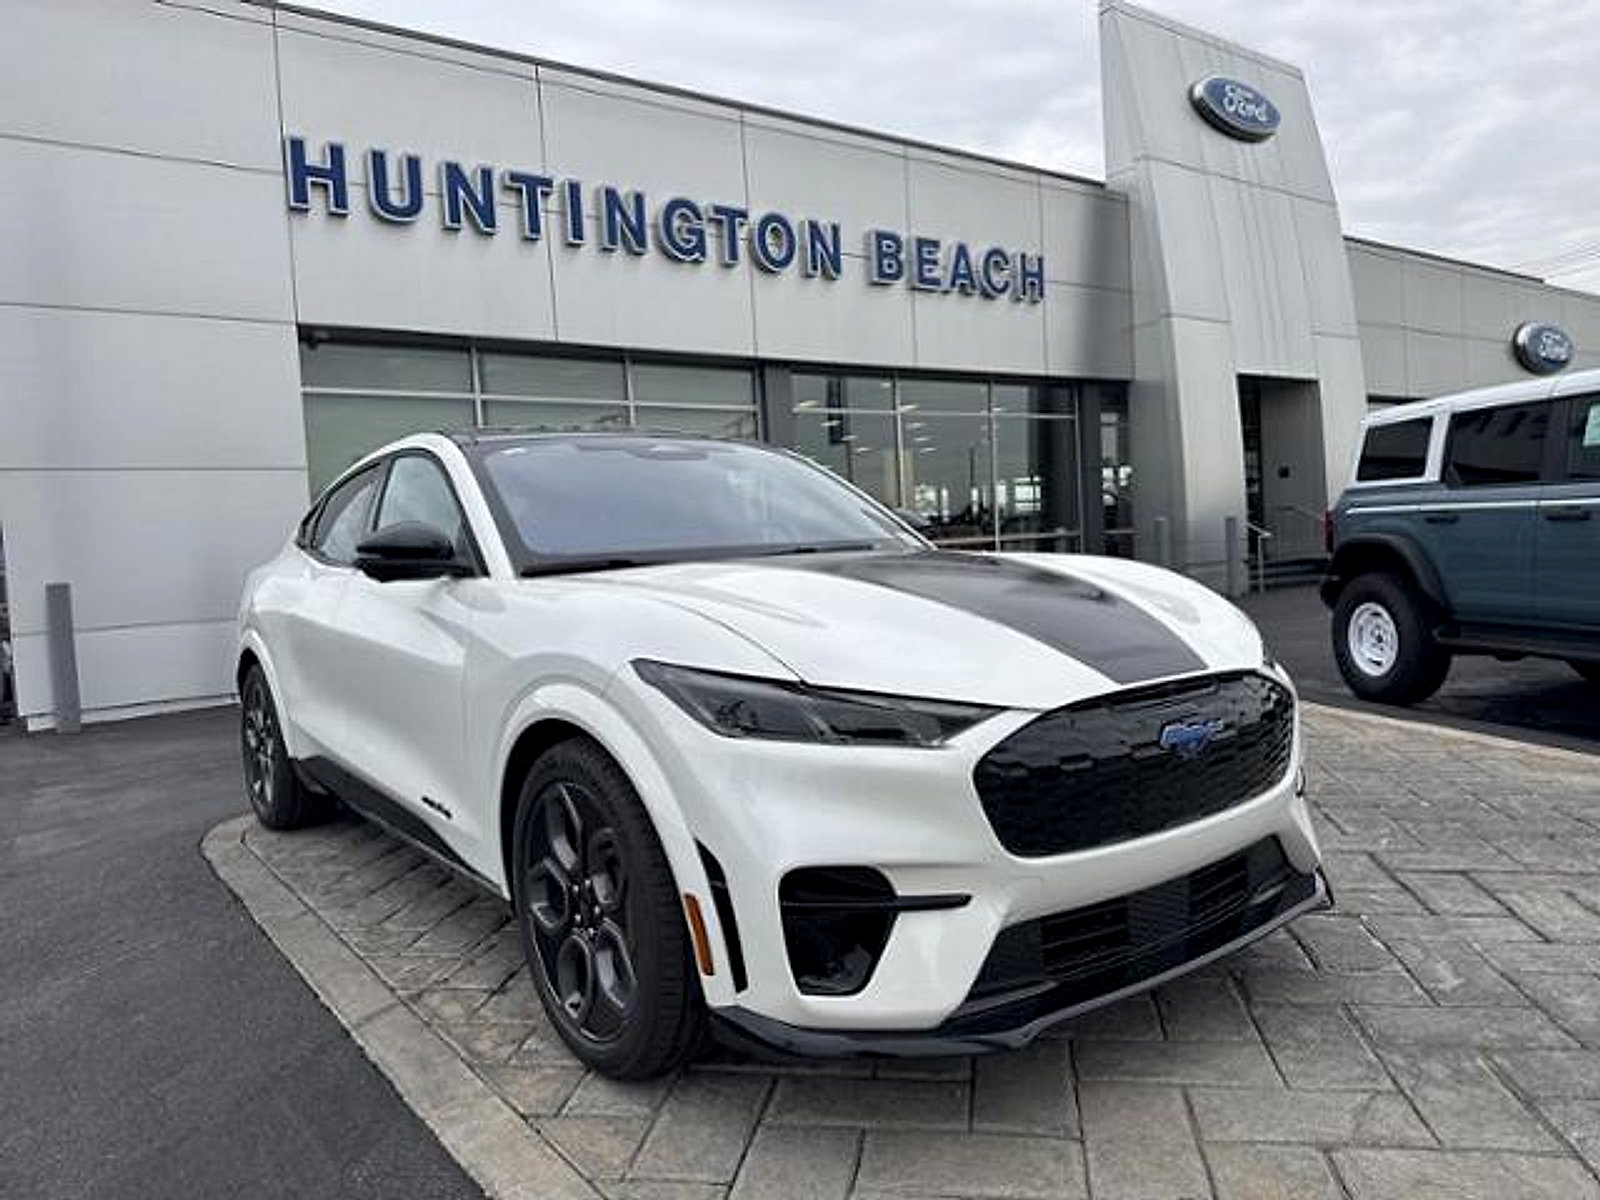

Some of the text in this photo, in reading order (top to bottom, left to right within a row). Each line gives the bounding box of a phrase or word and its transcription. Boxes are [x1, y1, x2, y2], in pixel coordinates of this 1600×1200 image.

[1222, 84, 1267, 121] Ford
[287, 136, 1045, 302] HUNTINGTON BEACH
